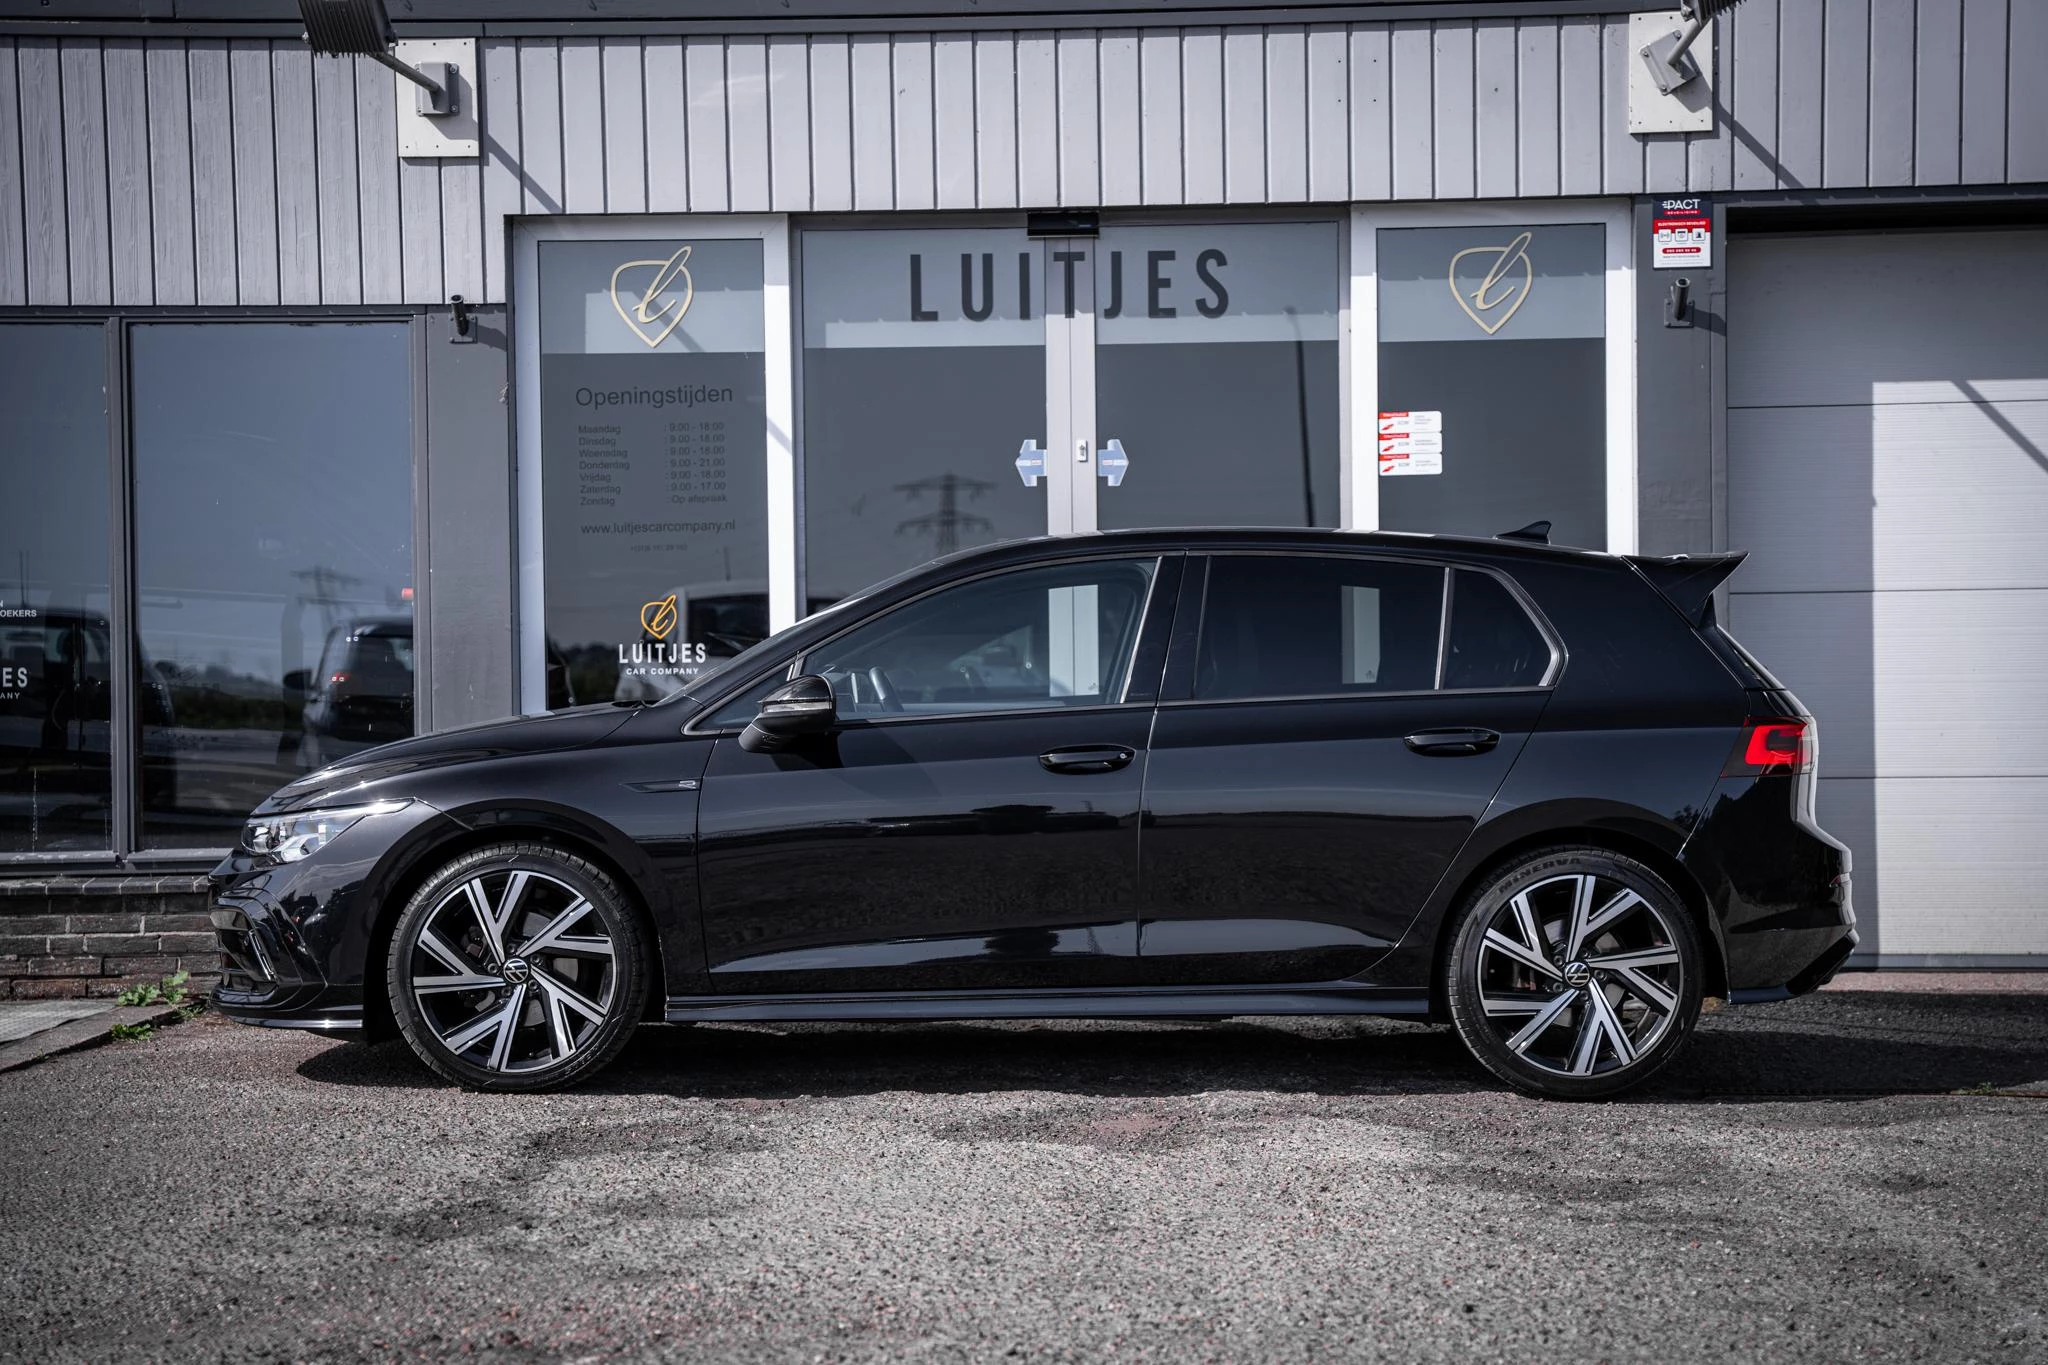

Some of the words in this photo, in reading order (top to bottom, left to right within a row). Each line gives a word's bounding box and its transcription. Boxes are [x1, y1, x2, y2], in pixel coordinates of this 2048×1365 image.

[1667, 199, 1701, 209] PACT
[910, 249, 1229, 322] LUITJES
[576, 385, 733, 410] Openingstijden
[578, 424, 621, 435] Maandag
[579, 437, 617, 448] Dinsdag
[580, 472, 611, 483] Vrijdag
[581, 520, 736, 534] www.luitjescarcompany.nl
[618, 643, 706, 664] LUITJES
[626, 667, 646, 675] CAR
[650, 667, 699, 675] COMPANY
[2, 667, 28, 688] ES
